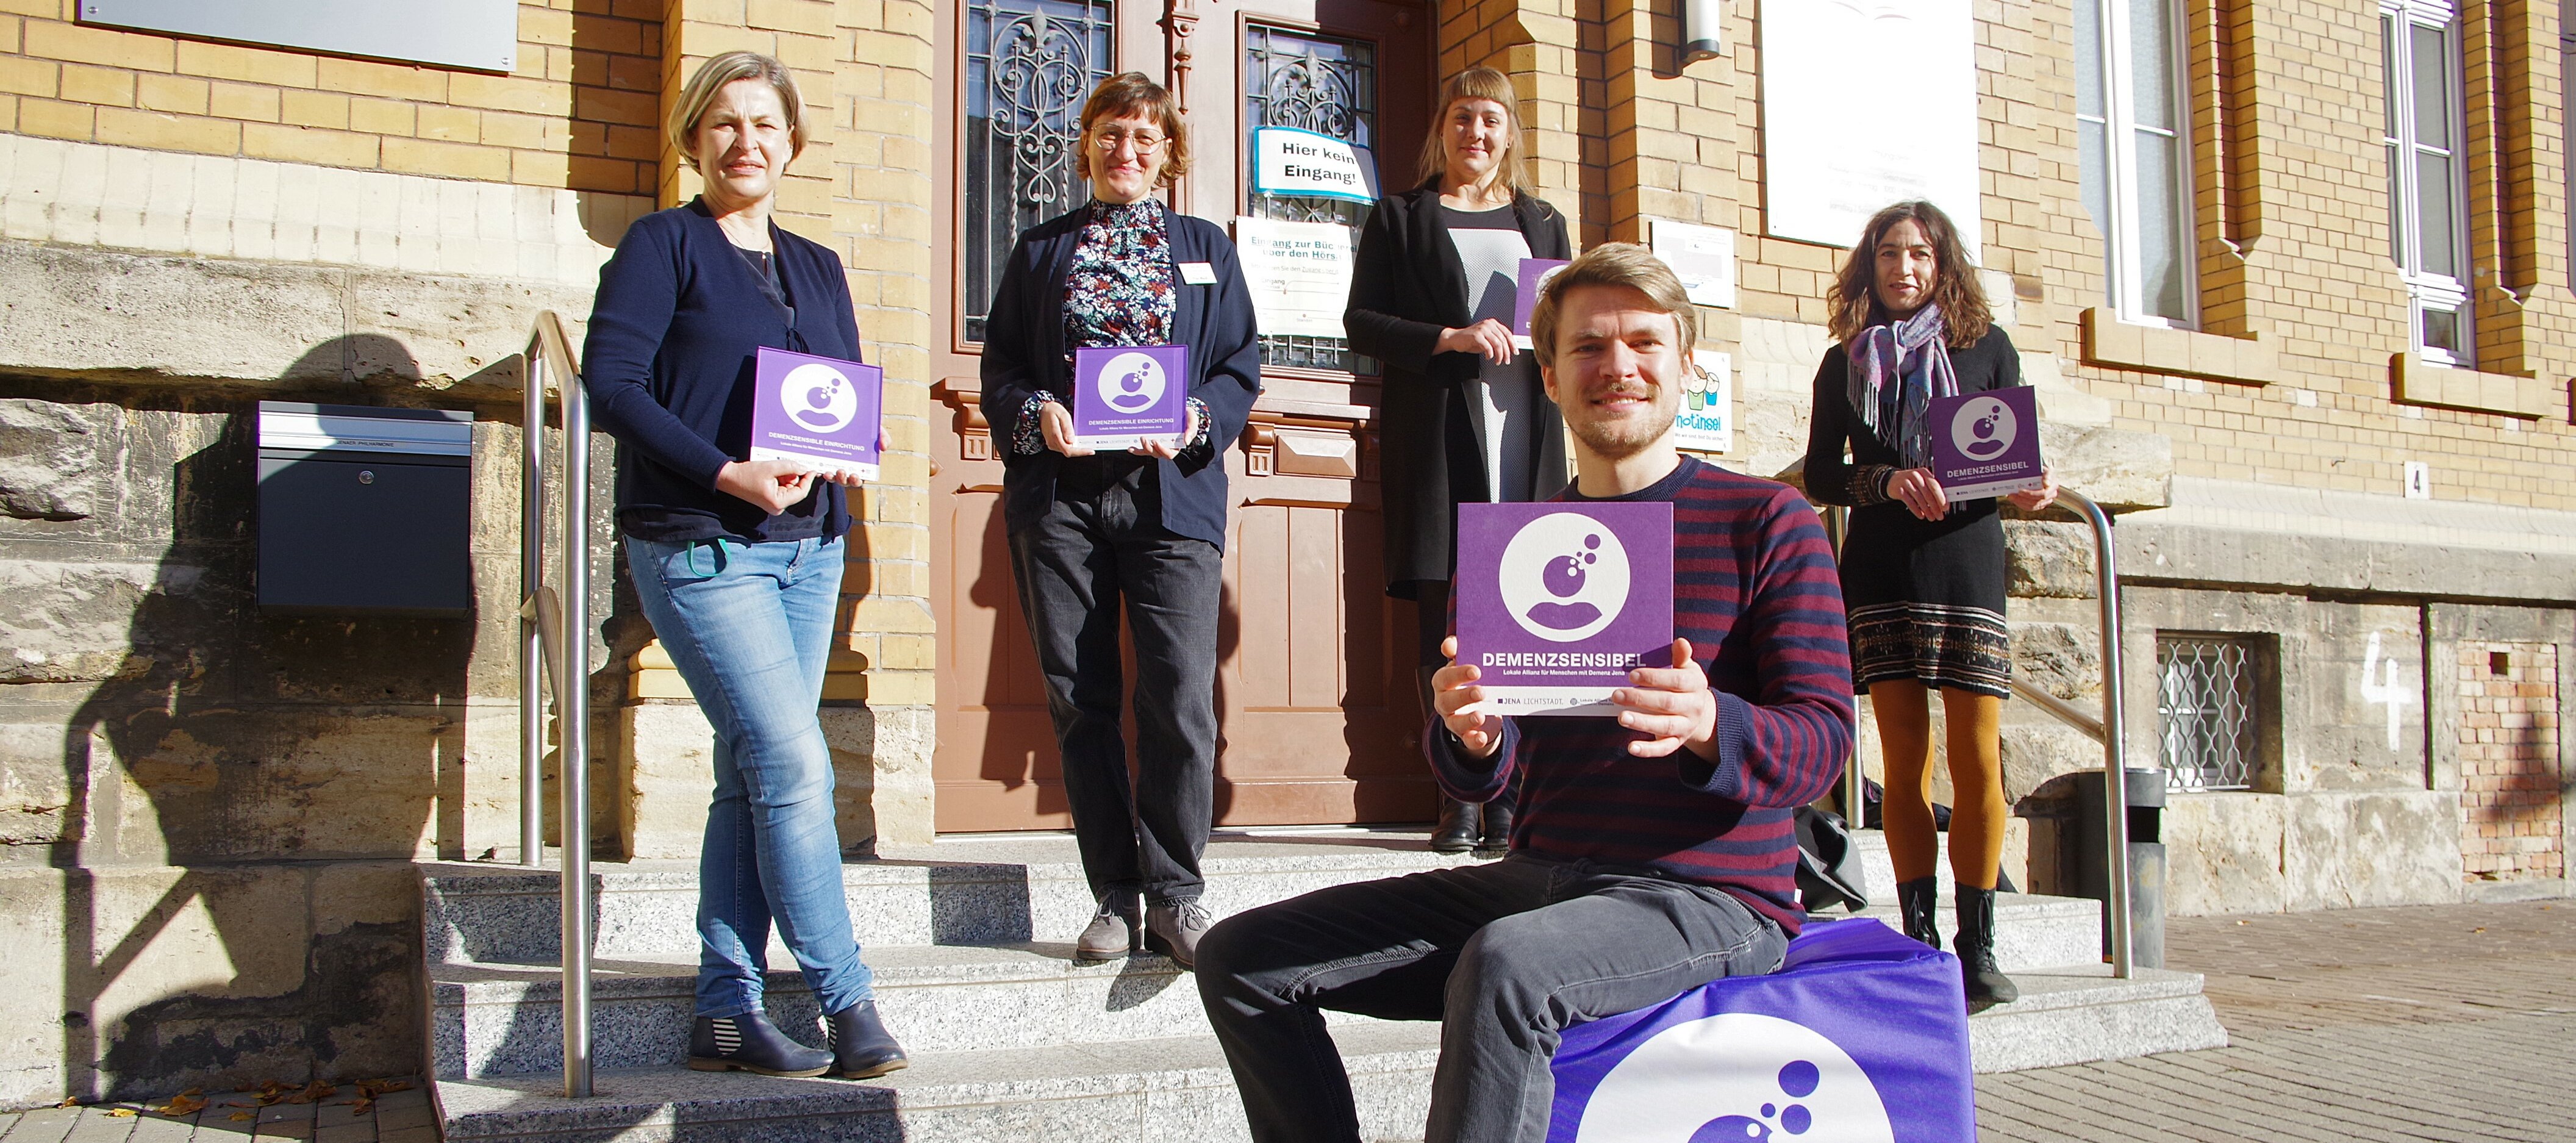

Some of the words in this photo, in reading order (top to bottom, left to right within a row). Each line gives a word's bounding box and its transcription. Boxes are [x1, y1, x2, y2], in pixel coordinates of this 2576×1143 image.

[1283, 143, 1317, 156] Hier
[1323, 148, 1354, 165] kein
[1284, 165, 1356, 185] Eingang!
[1289, 249, 1308, 258] den
[1676, 414, 1721, 431] notinsel
[768, 432, 823, 445] DEMENZSENSIBLE
[824, 440, 865, 451] EINRICHTUNG
[1947, 461, 2029, 478] DEMENZSENSIBEL
[2414, 470, 2420, 493] 4
[1483, 653, 1647, 667] DEMENZSENSIBEL
[2360, 631, 2412, 753] 4
